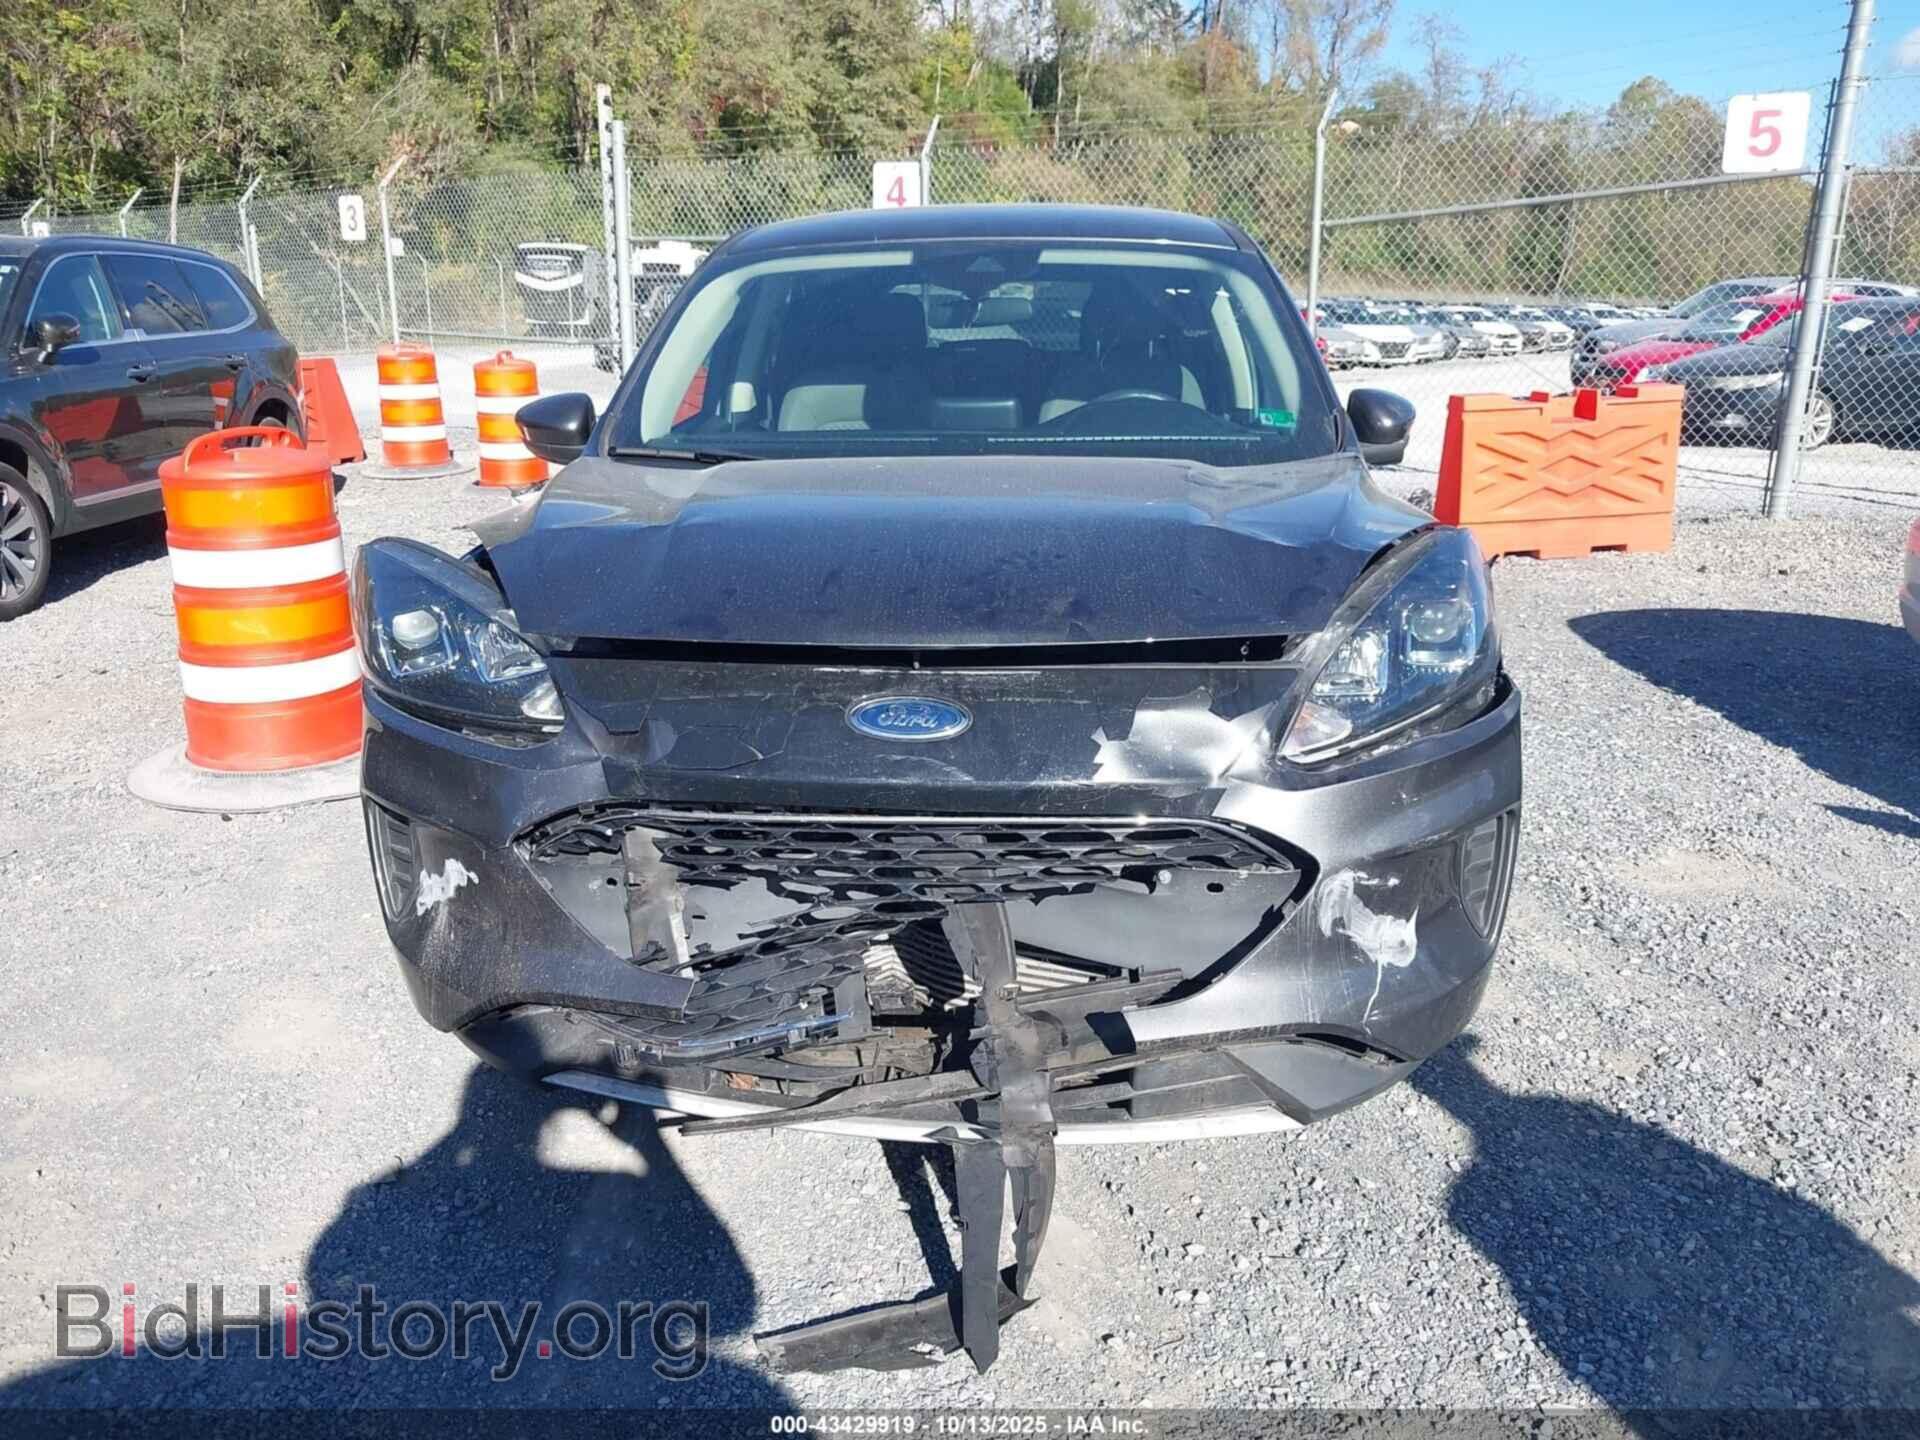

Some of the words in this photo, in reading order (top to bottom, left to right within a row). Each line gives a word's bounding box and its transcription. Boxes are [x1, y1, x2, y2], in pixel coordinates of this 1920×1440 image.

[1748, 109, 1783, 157] 5
[886, 175, 907, 207] 4
[347, 205, 358, 231] 3
[878, 704, 939, 728] Ford
